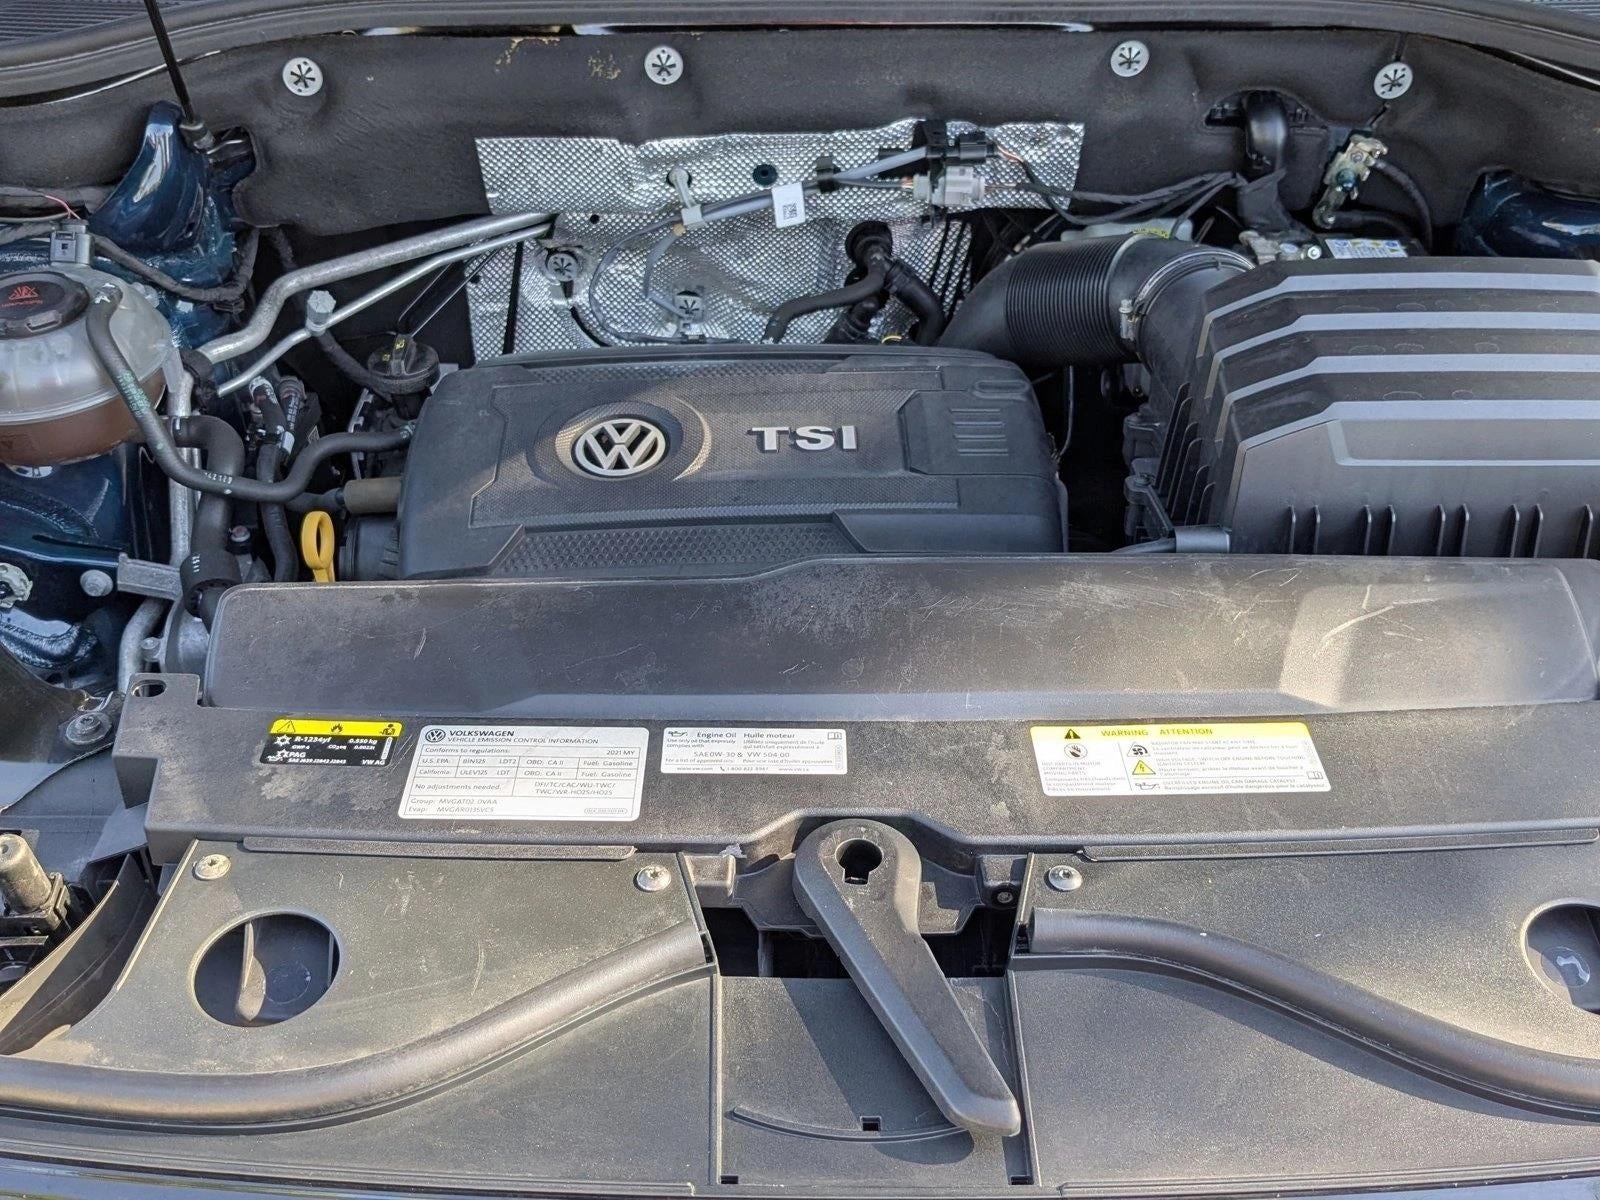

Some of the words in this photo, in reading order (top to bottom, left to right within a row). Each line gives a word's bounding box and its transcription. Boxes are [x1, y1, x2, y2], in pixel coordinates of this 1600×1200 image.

[751, 425, 857, 451] TSI
[1101, 729, 1149, 737] WARNING
[1159, 728, 1213, 736] ATTENTION
[426, 784, 472, 792] adjustments
